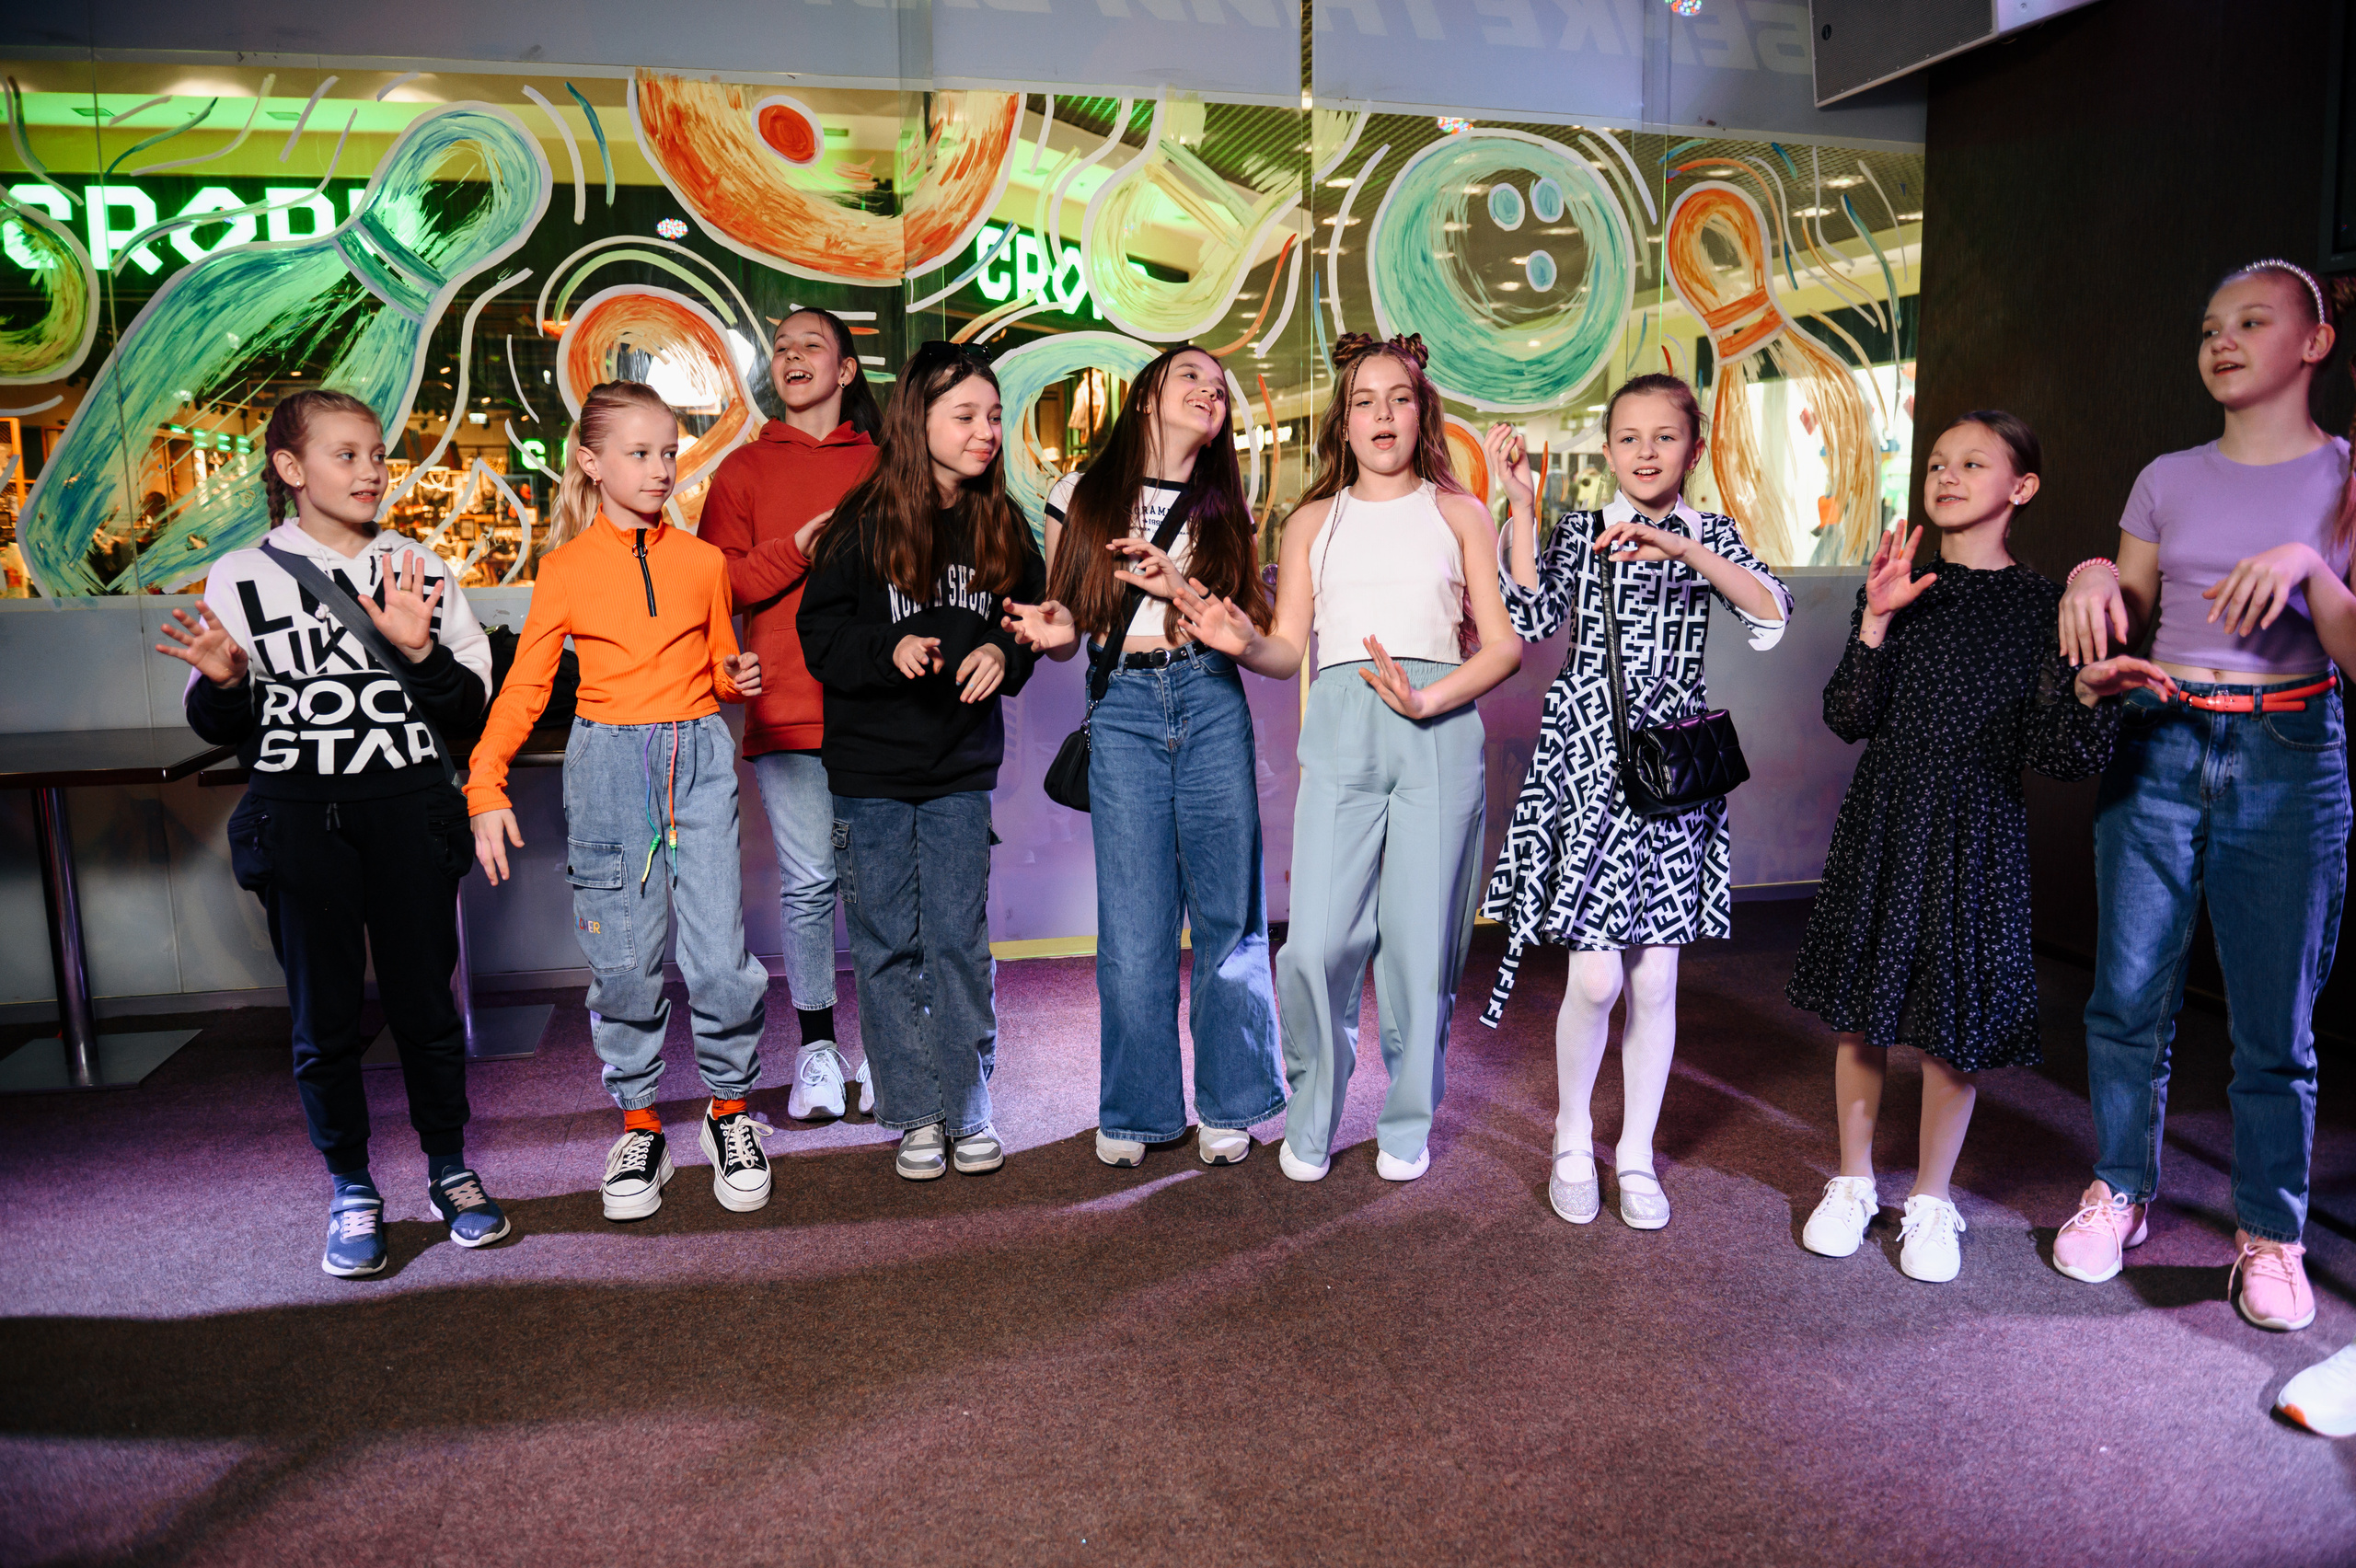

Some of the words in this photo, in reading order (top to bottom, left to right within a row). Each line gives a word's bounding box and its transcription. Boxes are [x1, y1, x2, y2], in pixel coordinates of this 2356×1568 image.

[3, 183, 410, 274] CROP
[261, 680, 413, 726] ROC
[254, 722, 439, 775] STAR
